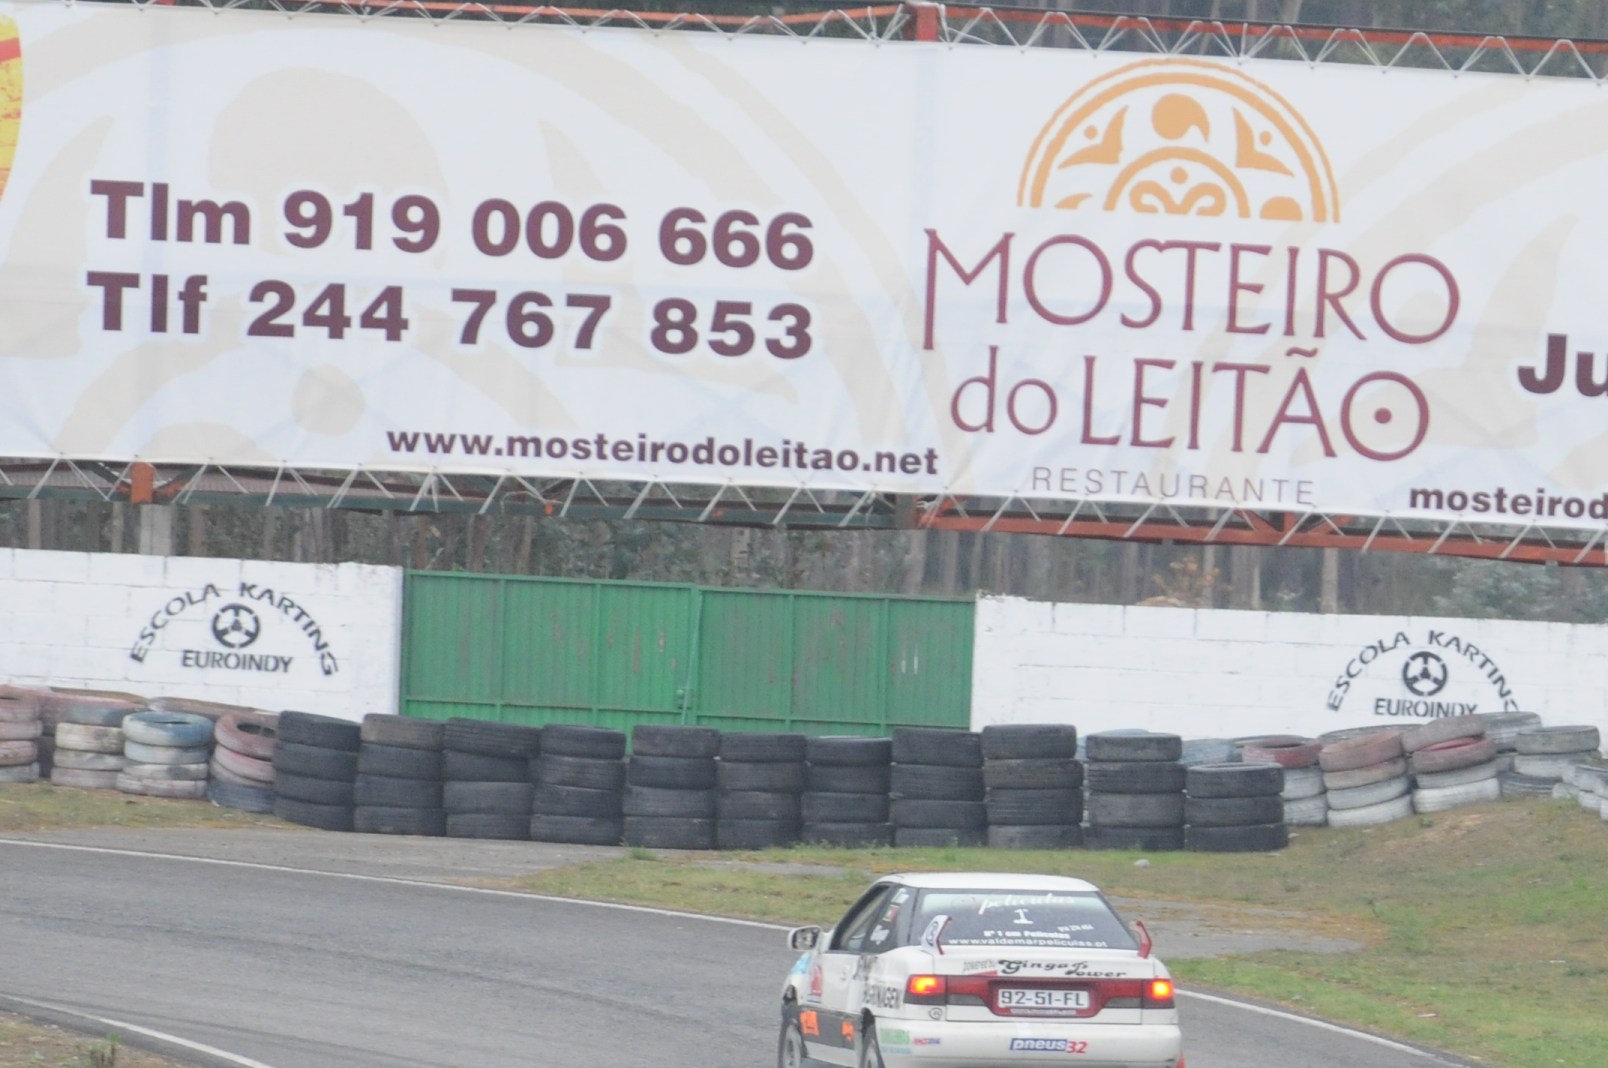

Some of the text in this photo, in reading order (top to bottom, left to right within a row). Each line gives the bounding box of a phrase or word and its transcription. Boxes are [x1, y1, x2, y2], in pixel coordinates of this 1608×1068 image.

[91, 180, 813, 270] Tlm 919 006 666
[87, 271, 812, 359] Tlf 244 767 853
[923, 229, 1460, 350] MOSTEIRO
[1080, 345, 1430, 462] LEITÃO
[386, 430, 938, 475] www.mosteirodoleitao.net
[1031, 466, 1315, 506] RESTAURANTE
[129, 581, 339, 676] ESCOLA KARTING
[181, 649, 294, 673] EUROINDY
[1326, 631, 1411, 712] ESCOLA
[1001, 991, 1085, 1007] 92-51-FL
